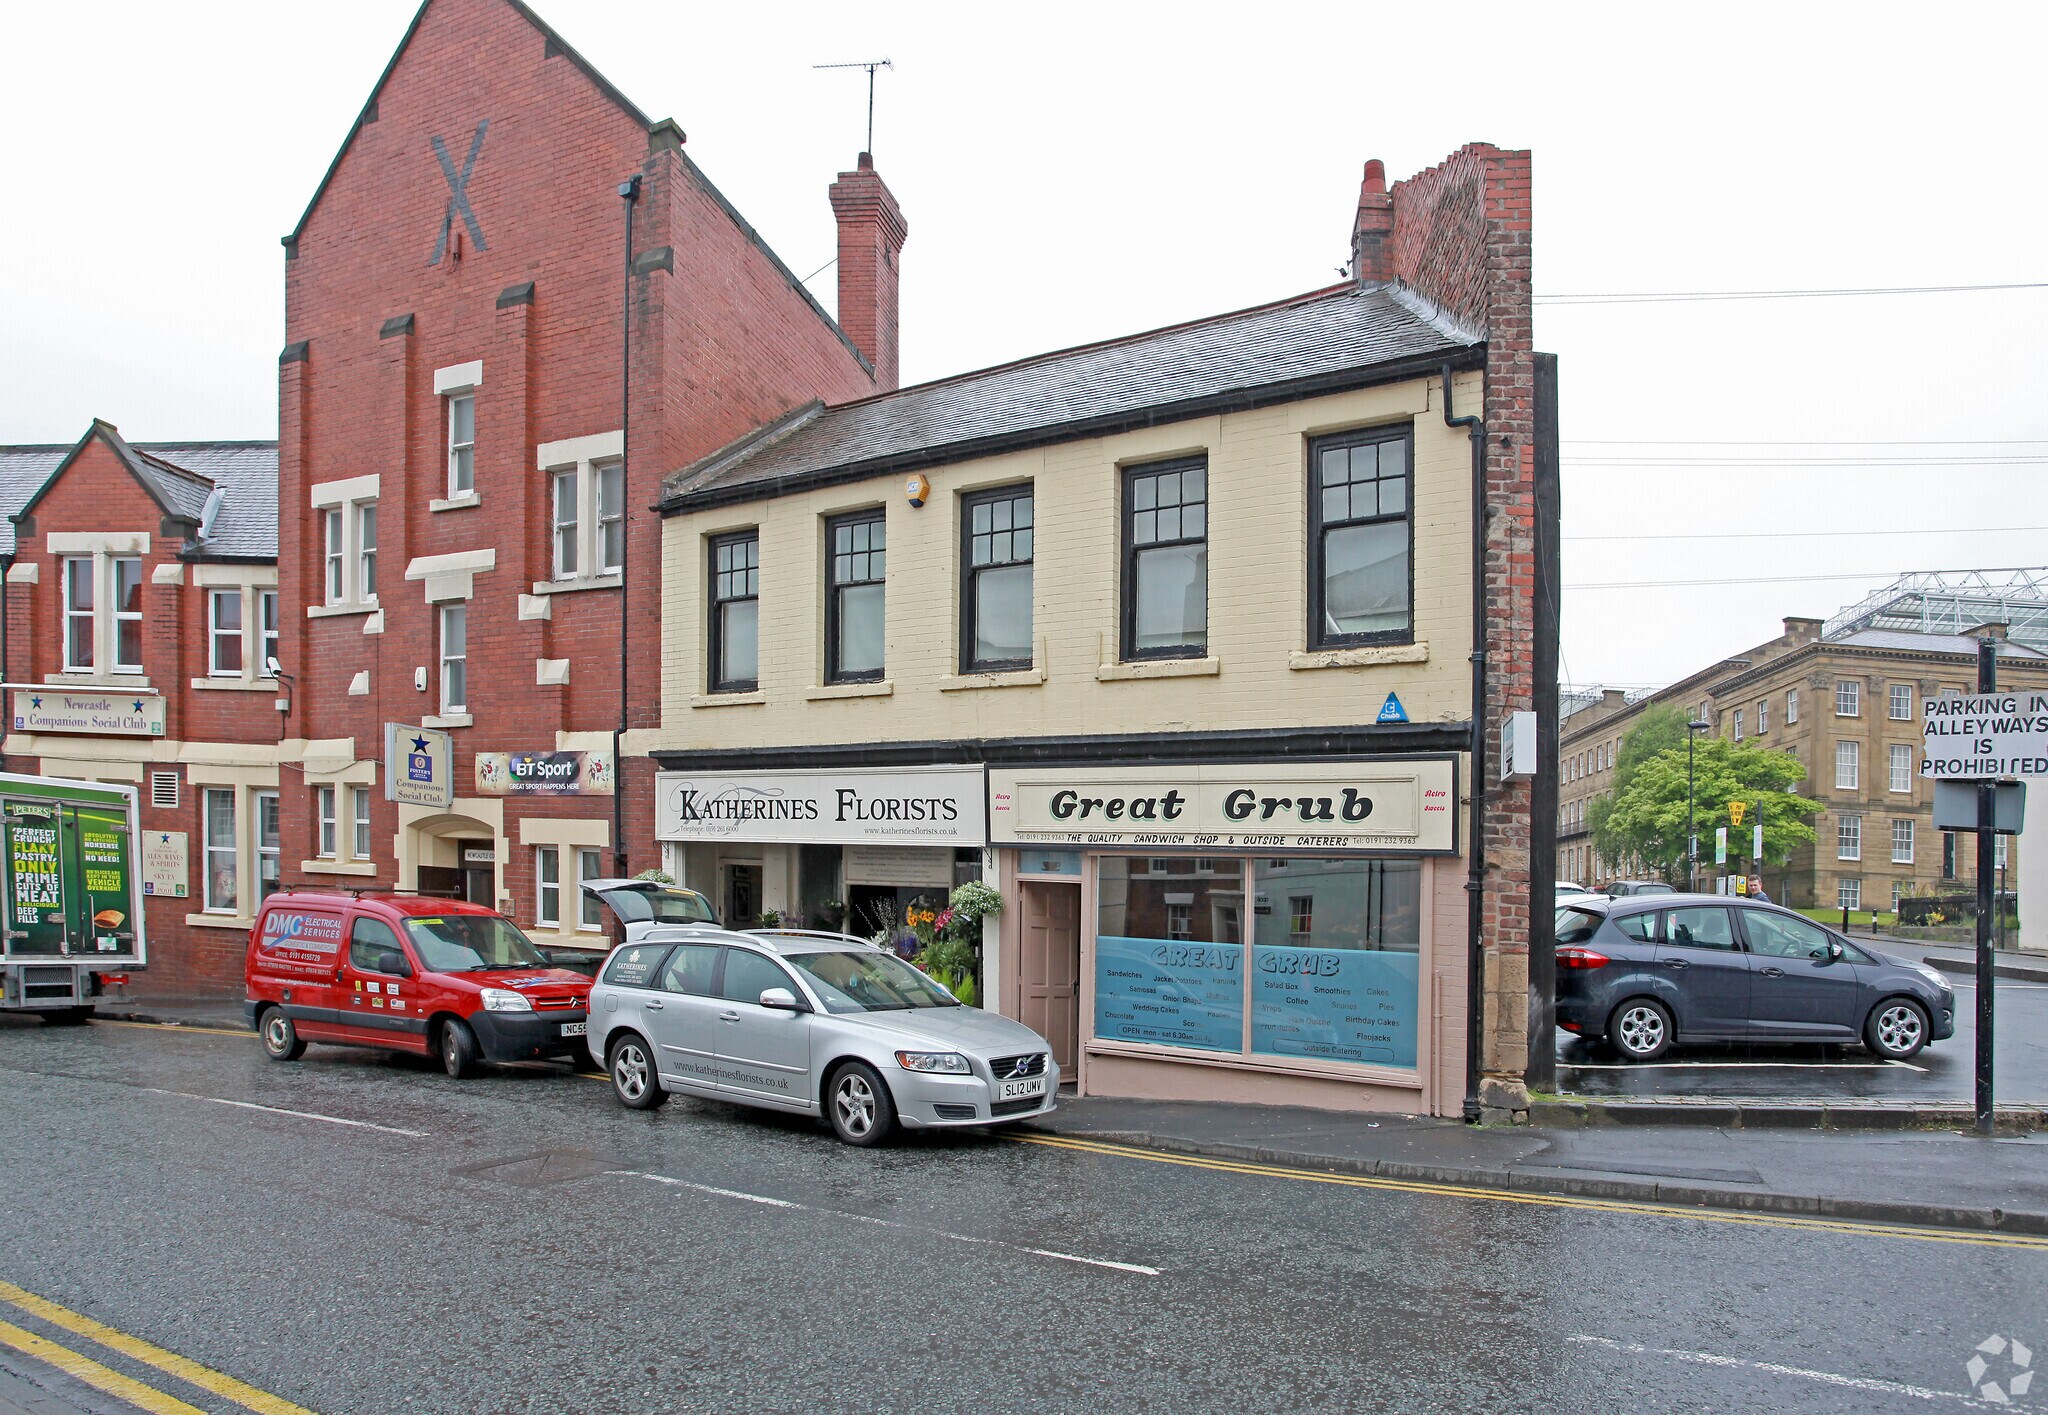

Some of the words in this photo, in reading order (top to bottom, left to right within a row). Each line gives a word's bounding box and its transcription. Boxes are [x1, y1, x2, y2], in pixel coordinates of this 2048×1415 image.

[64, 697, 111, 711] Newcastle
[1924, 698, 2016, 716] PARKING
[2029, 696, 2048, 712] IN
[29, 713, 88, 729] Companions
[92, 715, 120, 728] Social
[123, 716, 147, 729] Club
[1924, 716, 2048, 735] ALLEYWAYS
[1973, 738, 1993, 754] IS
[516, 763, 536, 776] BT
[537, 761, 572, 779] Sport
[1920, 757, 2048, 774] PROHIBITED
[410, 768, 431, 776] FOSTER'S
[396, 778, 444, 792] Companions
[397, 790, 421, 801] Social
[423, 793, 443, 803] Club
[1424, 789, 1446, 798] Retro
[679, 789, 819, 820] KATHERINES
[835, 788, 958, 822] FLORISTS
[1050, 789, 1185, 821] Great
[1222, 788, 1373, 823] Grub
[15, 805, 50, 817] PETERS
[84, 832, 119, 840] ABSOLUTELY
[863, 826, 958, 835] www.katherinesflorists.co.uk
[84, 841, 119, 850] NONSENSE
[1066, 833, 1082, 842] THE
[1087, 834, 1123, 843] QUALITY
[1133, 834, 1185, 844] SANDWICH
[1193, 835, 1219, 844] SHOP
[1228, 836, 1235, 845] &
[1243, 835, 1286, 845] OUTSIDE
[1297, 836, 1349, 847] CATERERS
[1399, 837, 1416, 845] 9363
[14, 842, 57, 854] FLAKY
[14, 852, 58, 862] PASTRY,
[15, 860, 57, 874] ONLY
[15, 872, 59, 884] PRIME
[87, 878, 121, 887] VEHICLE
[16, 882, 41, 891] CUTS
[46, 883, 59, 891] OF
[16, 890, 59, 903] MEAT
[17, 906, 38, 915] DEEP
[17, 915, 39, 924] FILLS
[305, 917, 342, 929] ELECTRICAL
[303, 927, 340, 939] SERVICES
[285, 940, 305, 949] DOMESTIC
[309, 942, 337, 952] COMMERCIAL
[616, 962, 647, 971] KATHERINES
[1151, 945, 1240, 971] GREAT
[1258, 951, 1340, 977] GRUB
[1107, 969, 1143, 979] Sandwiches
[1129, 985, 1157, 994] Samosas
[1264, 981, 1284, 990] Salad
[1285, 982, 1299, 991] Box
[1313, 986, 1351, 996] Smoothies
[1366, 987, 1390, 997] Cakes
[1162, 994, 1181, 1002] Onion
[1286, 996, 1309, 1006] Coffee
[1132, 1003, 1159, 1014] Wedding
[1160, 1006, 1180, 1014] Cakes
[1331, 1001, 1358, 1011] Scones
[1378, 1002, 1395, 1012] Pies
[1104, 1011, 1135, 1020] Chocolate
[1289, 1015, 1305, 1024] Ham
[1306, 1017, 1331, 1026] Quiche
[1345, 1016, 1376, 1026] Birthday
[1377, 1018, 1400, 1027] Cakes
[1122, 1026, 1140, 1035] OPEN
[1162, 1030, 1172, 1038] sat
[1172, 1031, 1194, 1040] 6.30am
[1356, 1032, 1392, 1043] Flapjacks
[1303, 1044, 1330, 1053] Outside
[1332, 1046, 1362, 1057] Catering
[673, 1061, 789, 1089] www.katherinesflorists.co.uk
[1005, 1082, 1025, 1096] SL12
[1026, 1079, 1041, 1093] UMV
